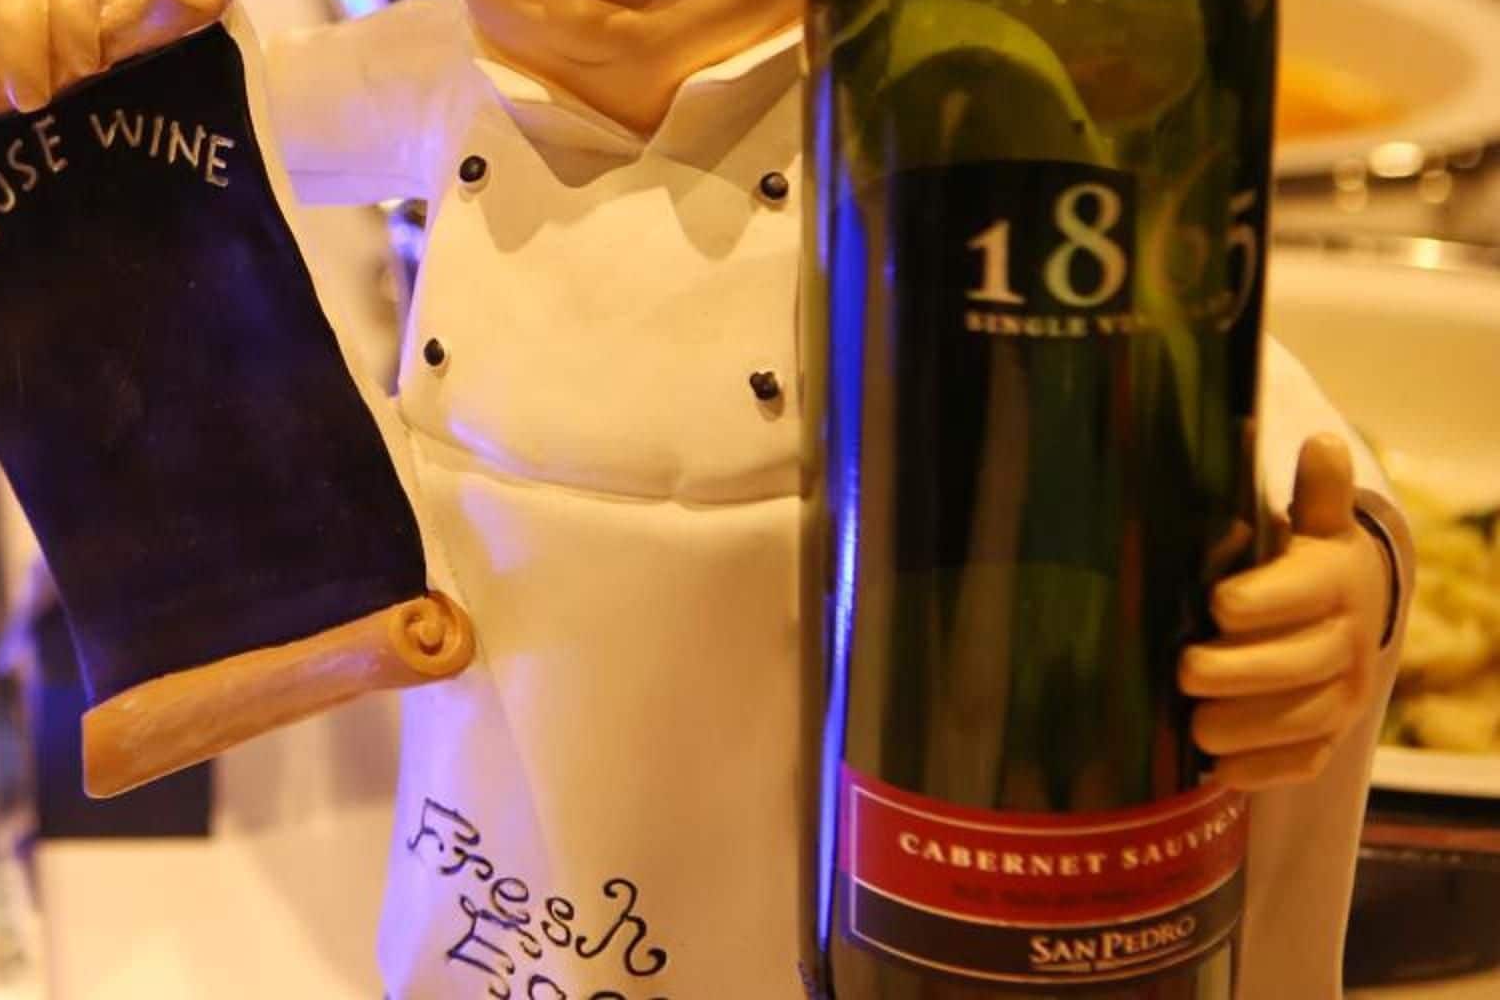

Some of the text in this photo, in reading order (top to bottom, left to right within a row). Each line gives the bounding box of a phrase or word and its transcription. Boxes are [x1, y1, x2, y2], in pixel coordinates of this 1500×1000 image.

[90, 108, 235, 187] WINE
[964, 310, 1089, 339] SINGLE
[899, 832, 1105, 876] CABERNET
